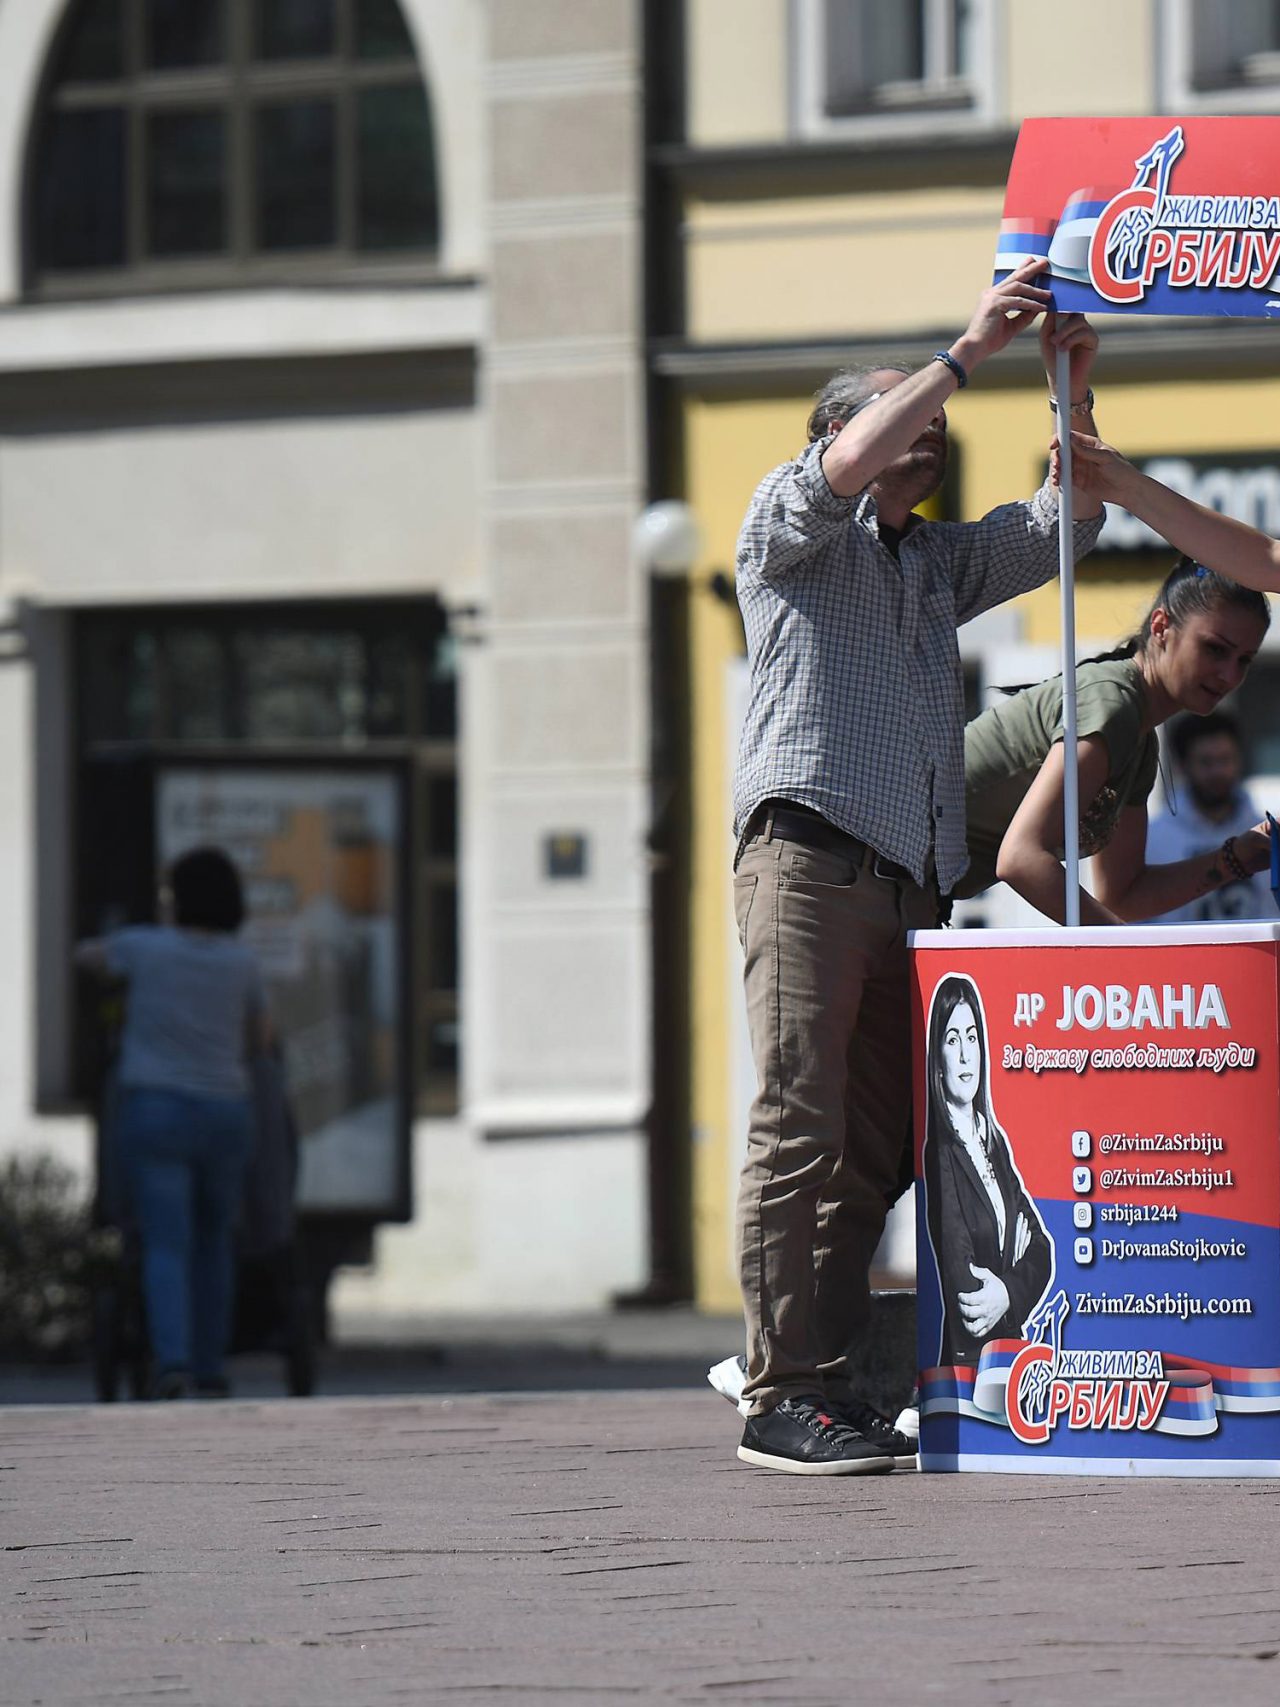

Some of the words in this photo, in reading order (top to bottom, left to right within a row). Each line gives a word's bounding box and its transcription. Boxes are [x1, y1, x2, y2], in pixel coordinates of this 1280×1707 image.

[1164, 196, 1250, 228] ЖИВИМ
[1252, 196, 1280, 228] ЗА
[1013, 993, 1046, 1027] ДР
[1056, 984, 1231, 1030] ЈОВАНА
[1002, 1044, 1021, 1069] За
[1024, 1044, 1088, 1073] државу
[1091, 1043, 1195, 1069] слободних
[1196, 1042, 1255, 1072] људи
[1099, 1133, 1223, 1155] @ZivimZaSrbiju
[1100, 1168, 1233, 1190] @ZivimZaSrbiju1
[1100, 1204, 1178, 1226] srbija1244
[1101, 1238, 1246, 1262] DrJovanaStojkovic
[1075, 1292, 1252, 1320] ZivimZaSrbiju.com
[1060, 1351, 1135, 1378] ЖИВИМ
[1136, 1351, 1163, 1378] ЗА
[1006, 1344, 1169, 1443] СРБИЈУ
